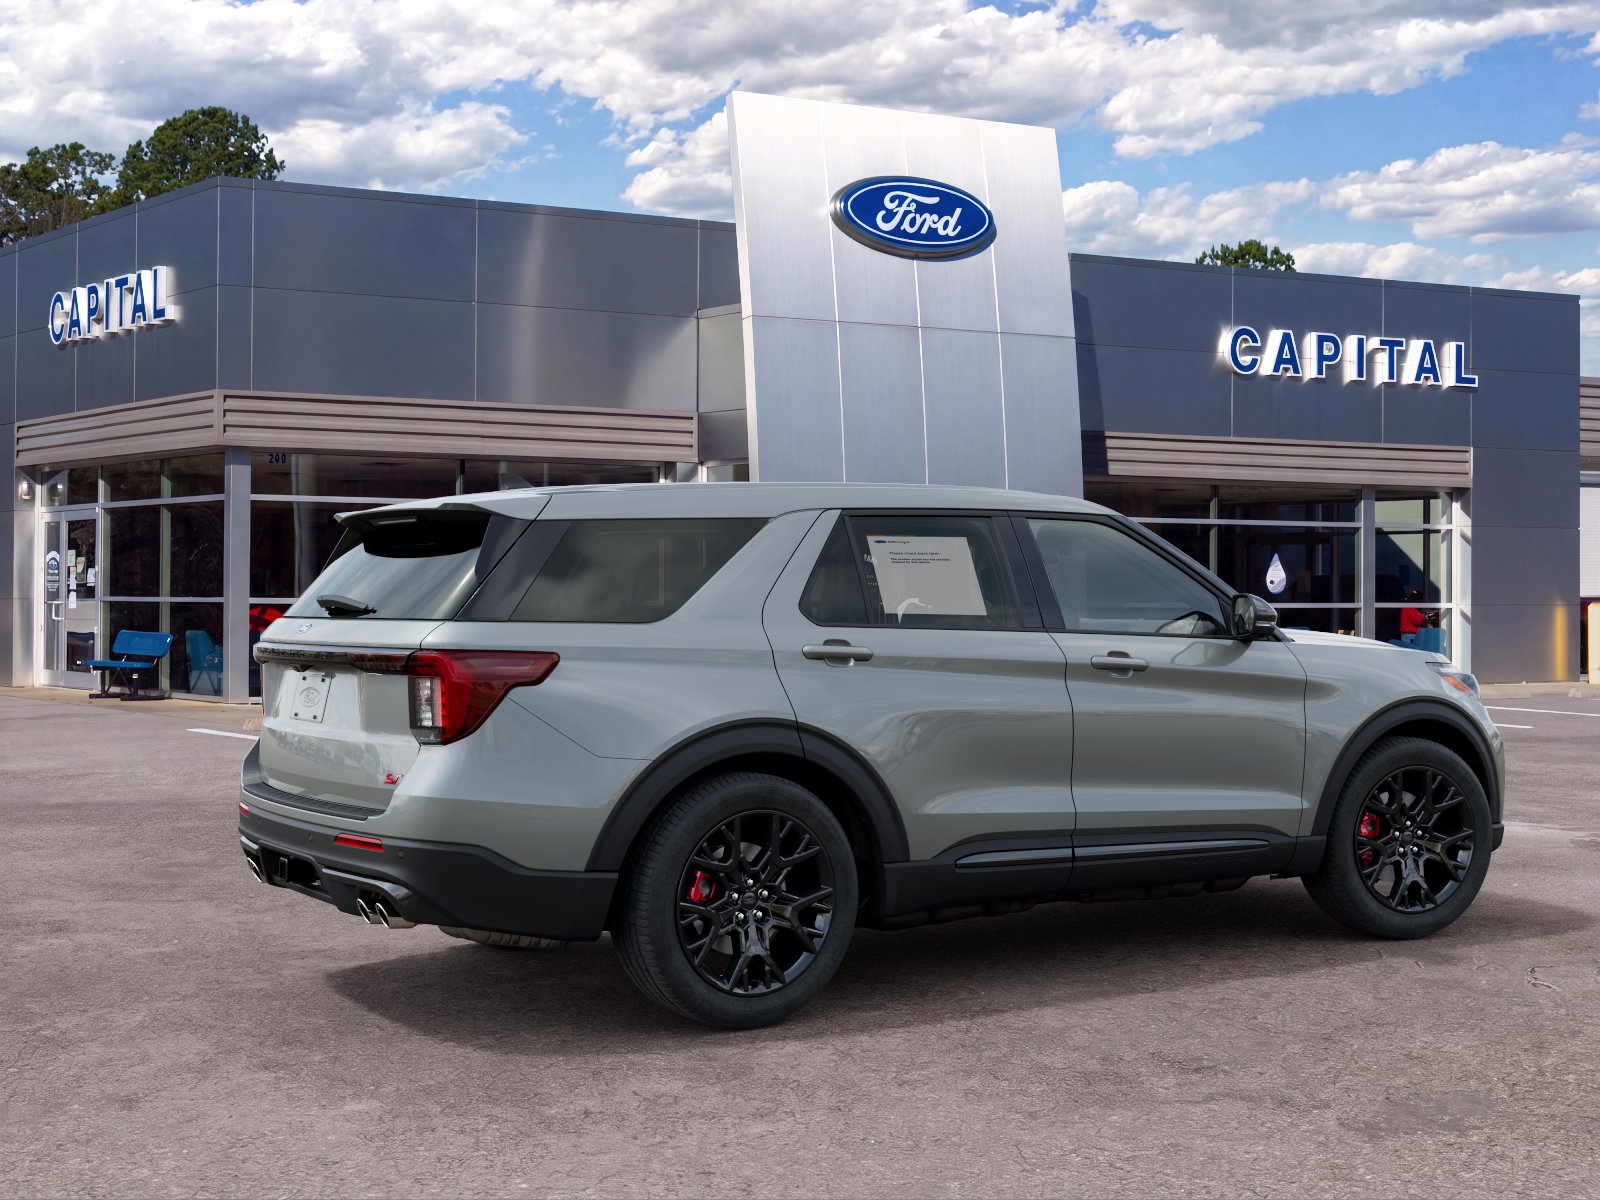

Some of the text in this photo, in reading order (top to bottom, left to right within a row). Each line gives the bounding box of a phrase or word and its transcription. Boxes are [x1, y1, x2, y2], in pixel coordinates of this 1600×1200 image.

[875, 190, 963, 237] Ford
[49, 265, 170, 345] CAPITAL
[1226, 325, 1480, 389] CAPITAL
[268, 453, 287, 464] 200
[383, 773, 404, 786] ST
